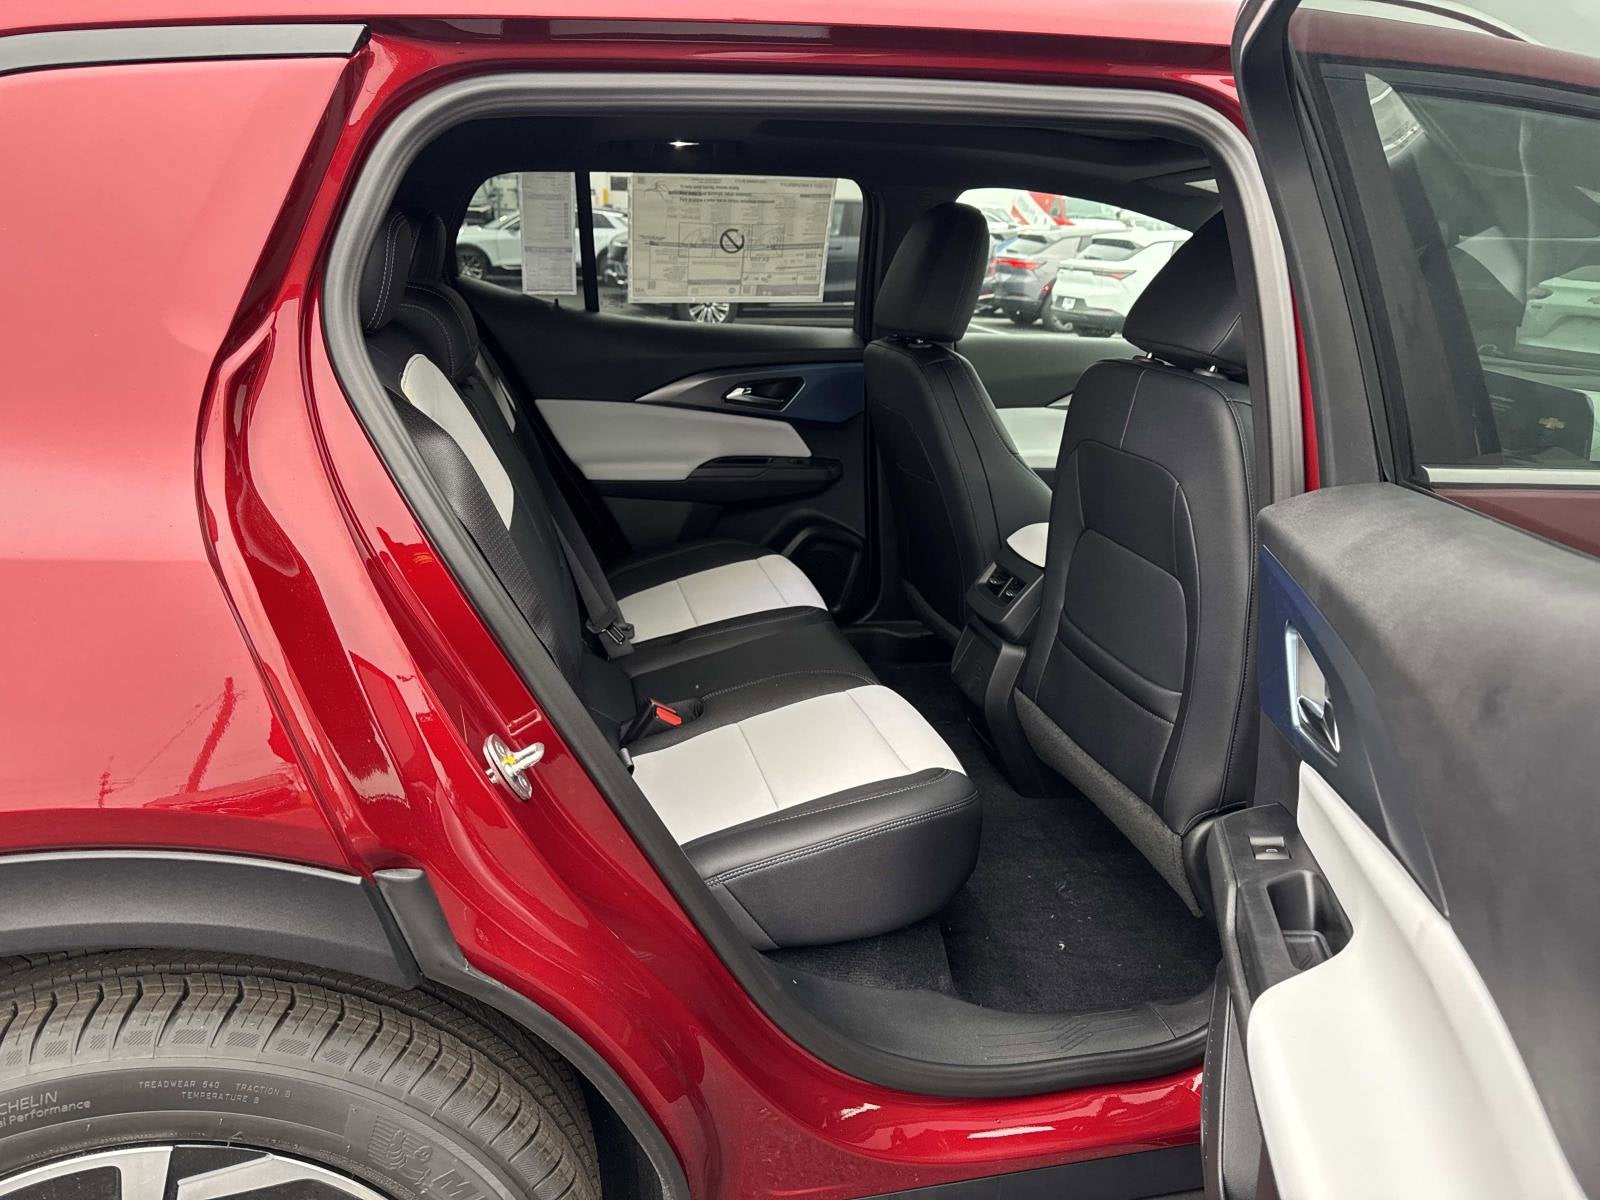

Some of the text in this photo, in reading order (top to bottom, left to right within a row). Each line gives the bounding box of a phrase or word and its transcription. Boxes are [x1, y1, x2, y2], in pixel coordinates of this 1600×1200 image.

[137, 1080, 196, 1089] TREADWEAR
[202, 1080, 220, 1089] 540
[235, 1082, 280, 1096] TRACTION
[181, 1091, 249, 1103] TEMPERATURE
[8, 1100, 91, 1125] Performance
